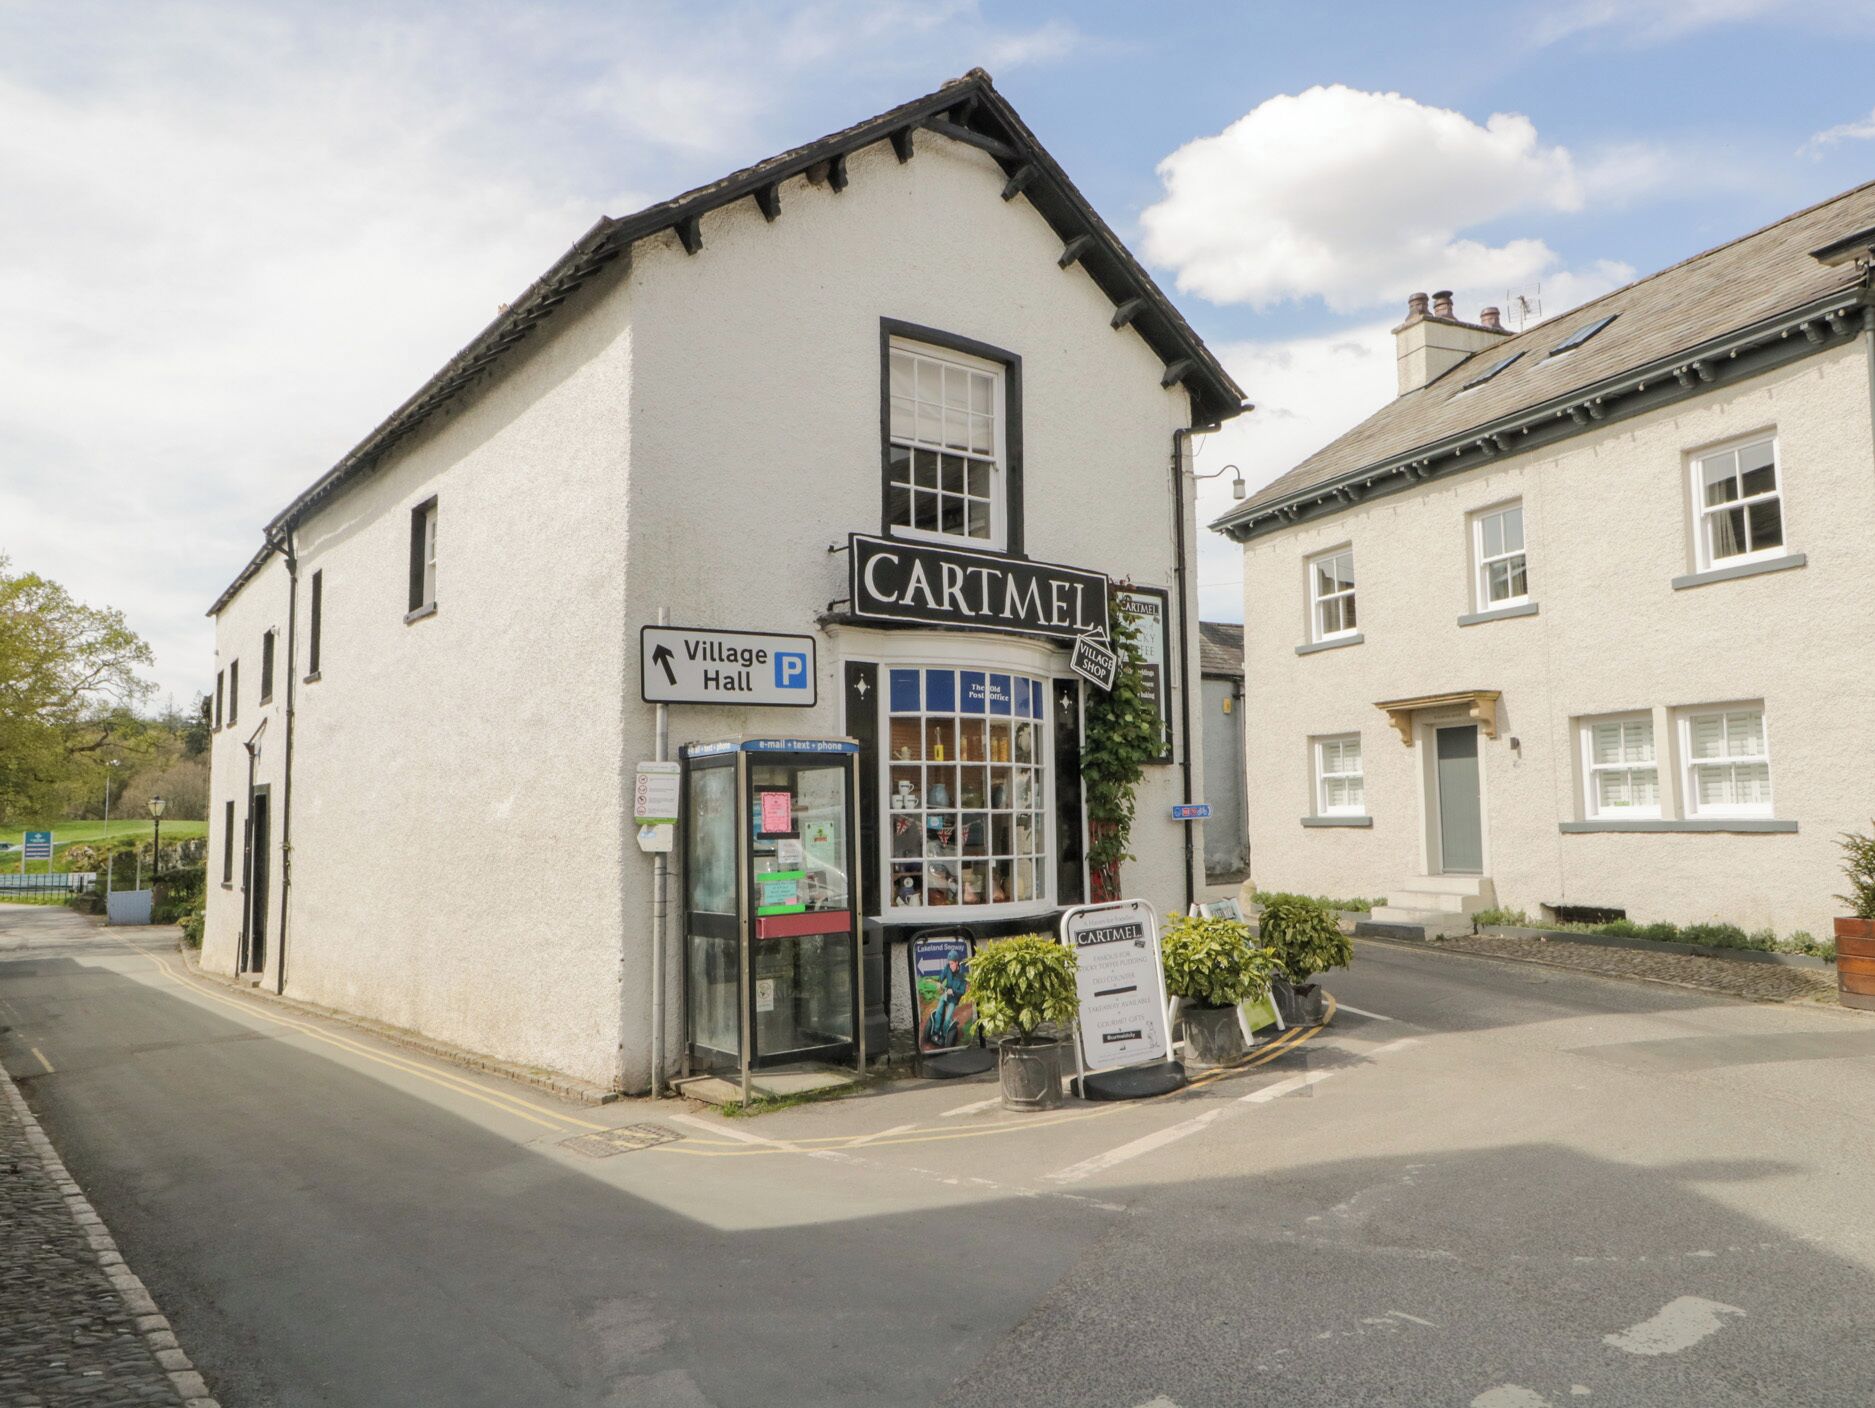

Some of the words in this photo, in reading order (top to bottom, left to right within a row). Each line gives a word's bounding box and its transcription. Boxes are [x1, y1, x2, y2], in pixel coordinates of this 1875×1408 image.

[864, 553, 1096, 631] CARTMEL
[684, 639, 768, 668] Village
[1080, 642, 1114, 671] VILLAGE
[782, 656, 803, 686] P
[1082, 658, 1107, 679] SHOP
[703, 669, 753, 692] Hall
[971, 683, 985, 691] The
[989, 685, 1001, 693] Old
[968, 691, 985, 699] Post
[989, 693, 1009, 702] Office
[759, 739, 785, 749] e-mail
[793, 741, 810, 750] text
[817, 741, 843, 751] phone
[1078, 925, 1139, 945] CARTMEL
[917, 943, 943, 953] Lakeland
